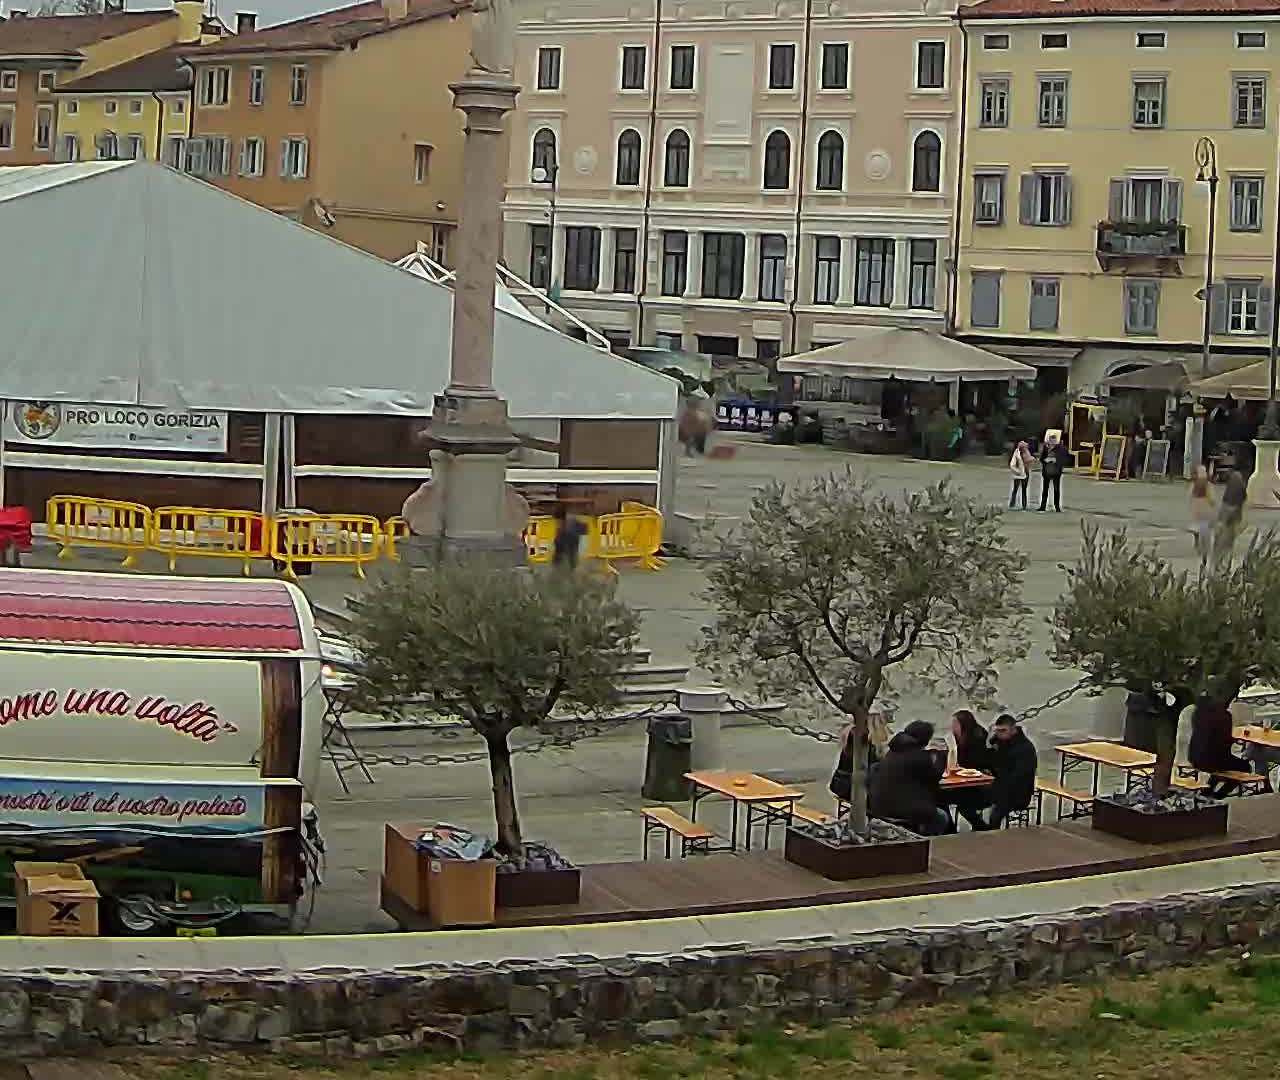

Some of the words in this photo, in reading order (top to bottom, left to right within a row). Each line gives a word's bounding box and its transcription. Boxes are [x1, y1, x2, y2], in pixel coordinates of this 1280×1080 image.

[66, 409, 100, 425] PRO
[104, 410, 149, 427] LOCO
[153, 412, 220, 428] GORIZIA
[63, 688, 131, 716] una
[93, 791, 120, 812] al
[119, 794, 180, 816] vostro
[176, 794, 247, 824] palato
